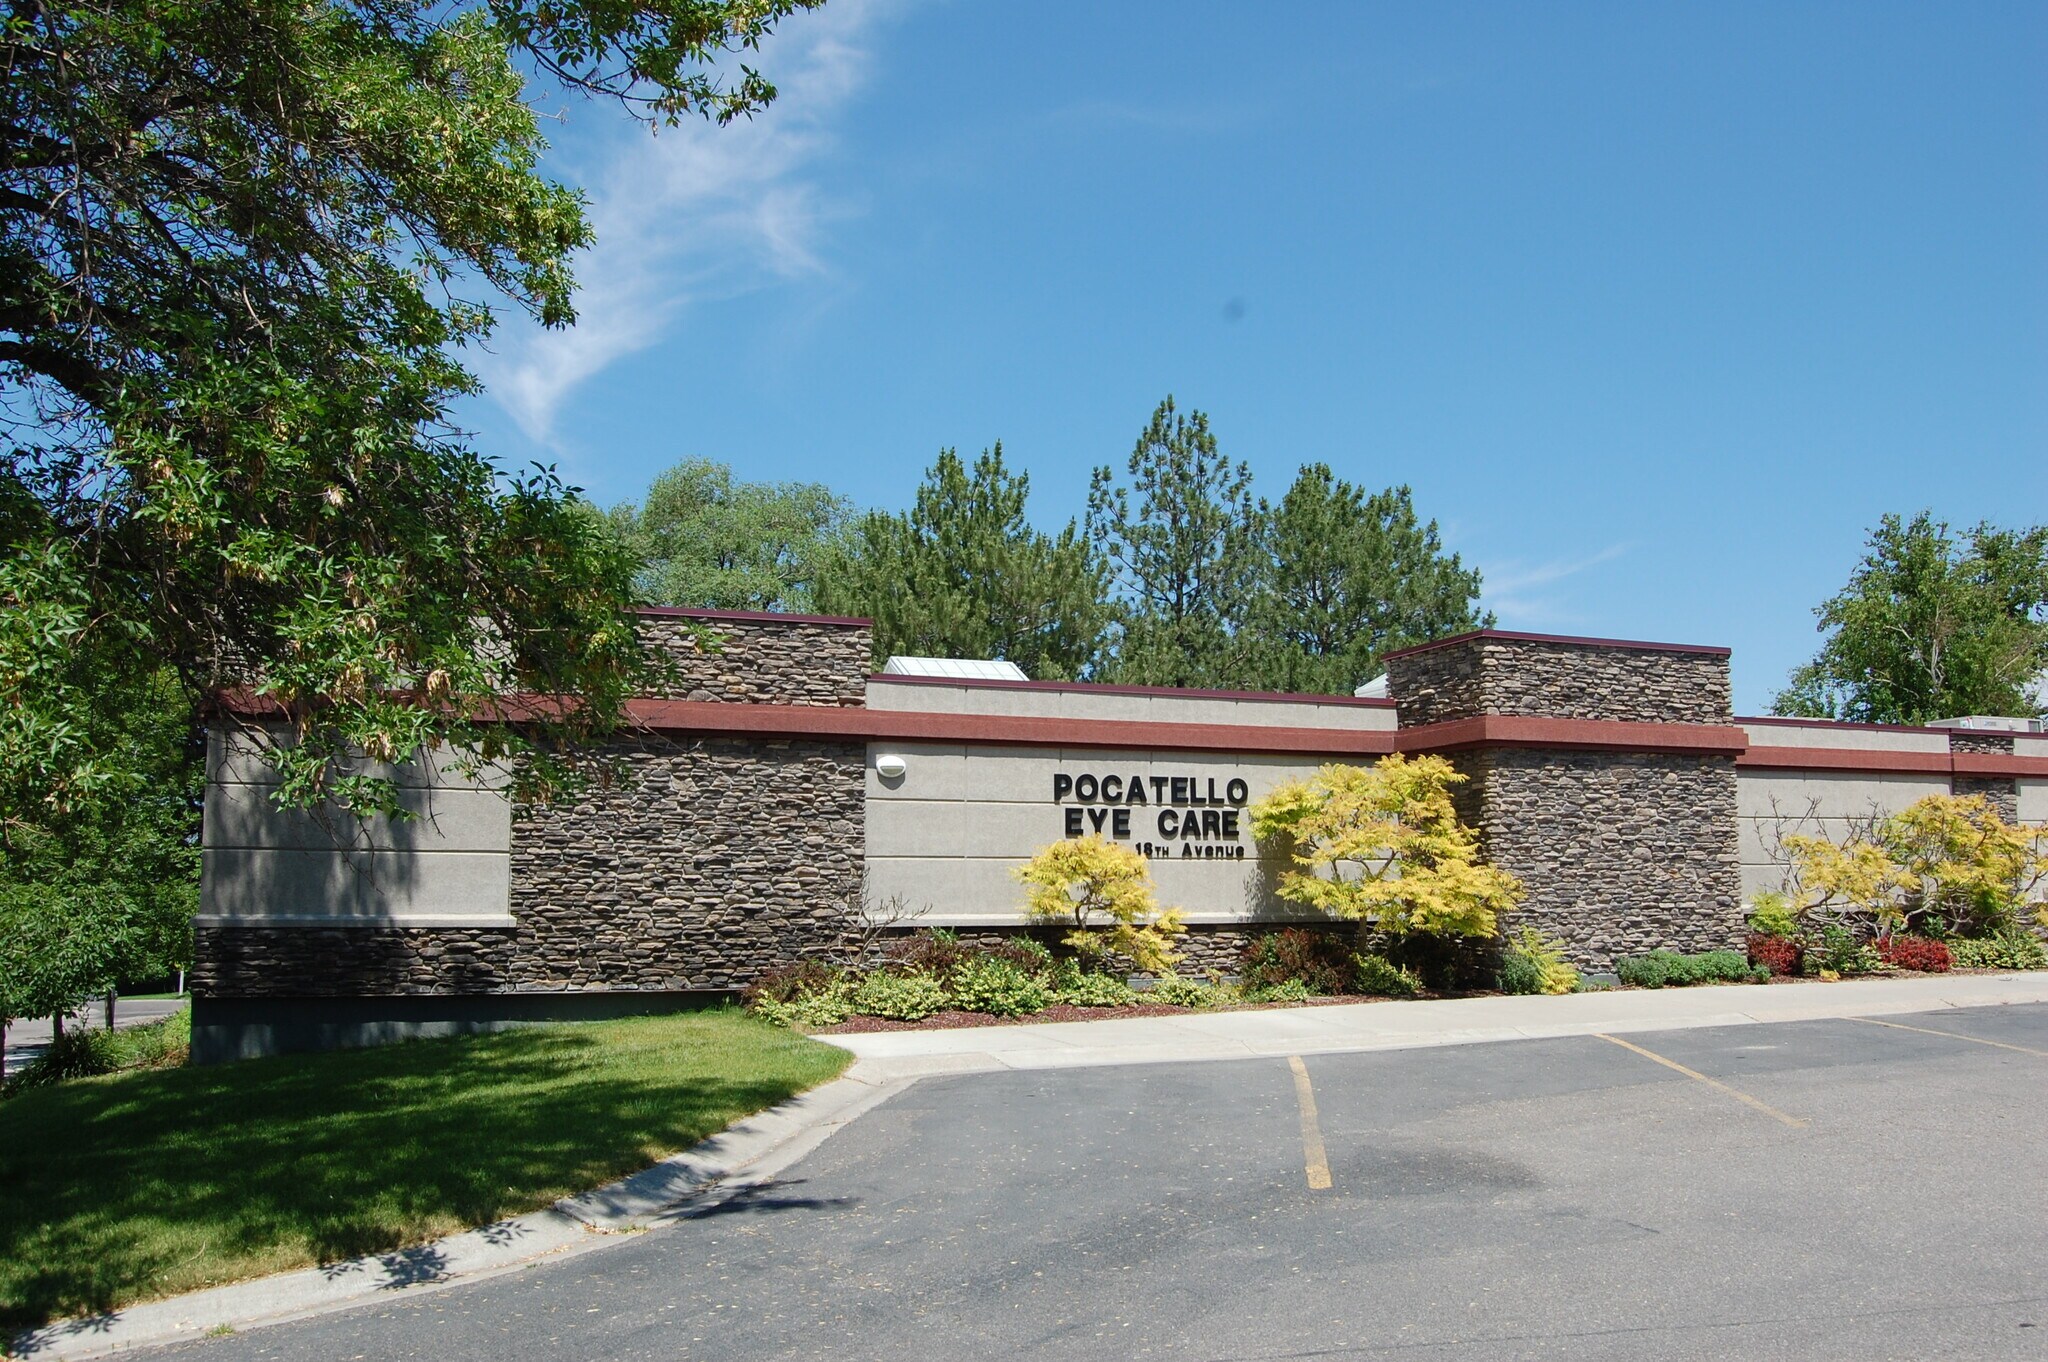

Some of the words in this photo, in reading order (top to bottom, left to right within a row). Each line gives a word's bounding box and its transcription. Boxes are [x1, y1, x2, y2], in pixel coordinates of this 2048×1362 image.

[1053, 773, 1248, 804] POCATELLO
[1065, 808, 1130, 836] EYE
[1157, 809, 1240, 837] CARE
[1181, 842, 1245, 857] Avenue
